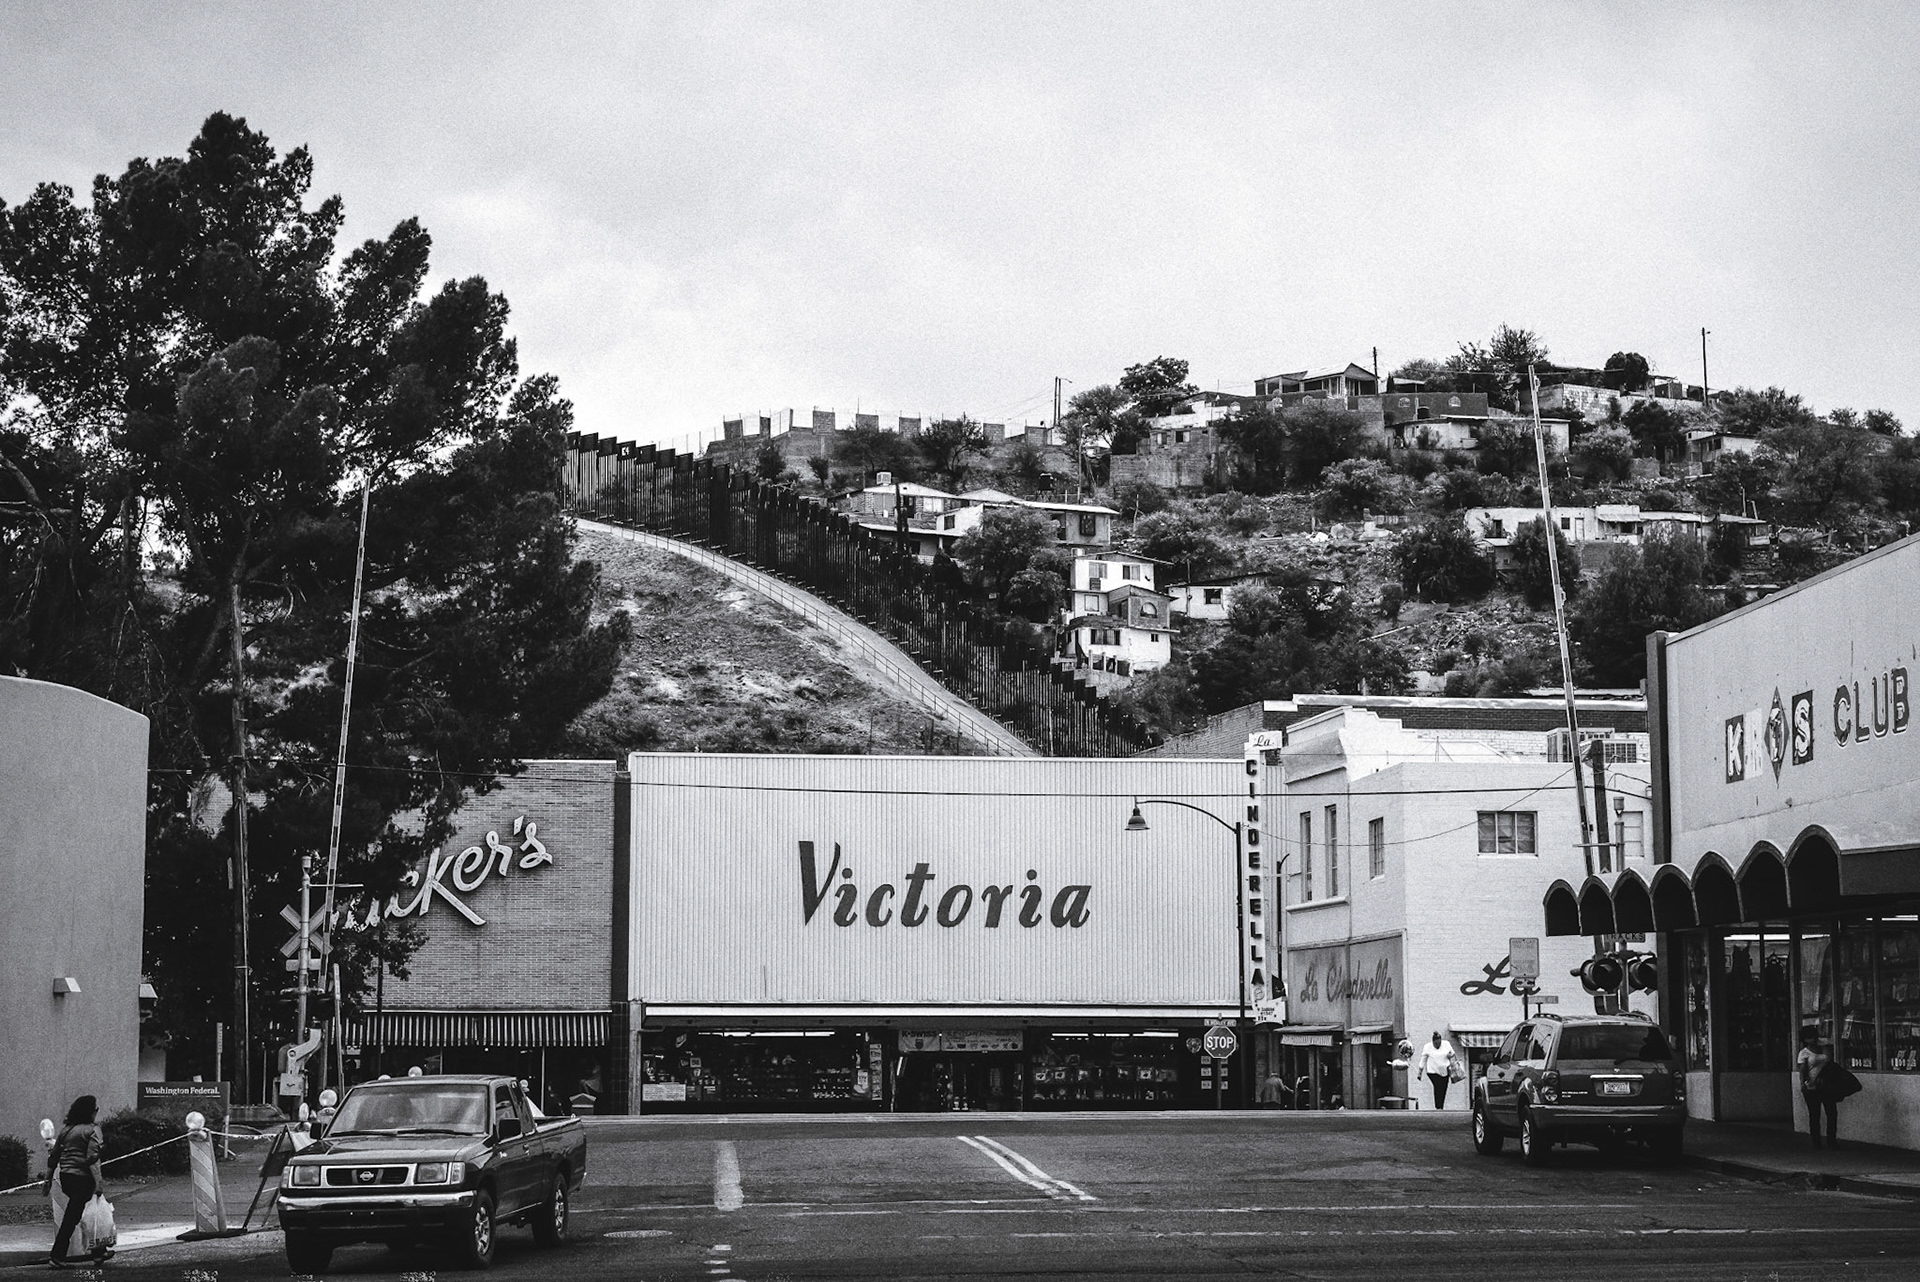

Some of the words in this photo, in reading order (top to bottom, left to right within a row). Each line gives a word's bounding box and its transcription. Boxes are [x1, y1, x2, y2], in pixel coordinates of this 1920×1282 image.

[1834, 666, 1910, 749] CLUB
[1254, 735, 1273, 747] La
[798, 840, 1092, 929] Victoria
[1246, 759, 1264, 985] CINDERELLA
[1301, 963, 1318, 1003] La
[1206, 1036, 1234, 1049] STOP
[145, 1086, 190, 1096] Washington
